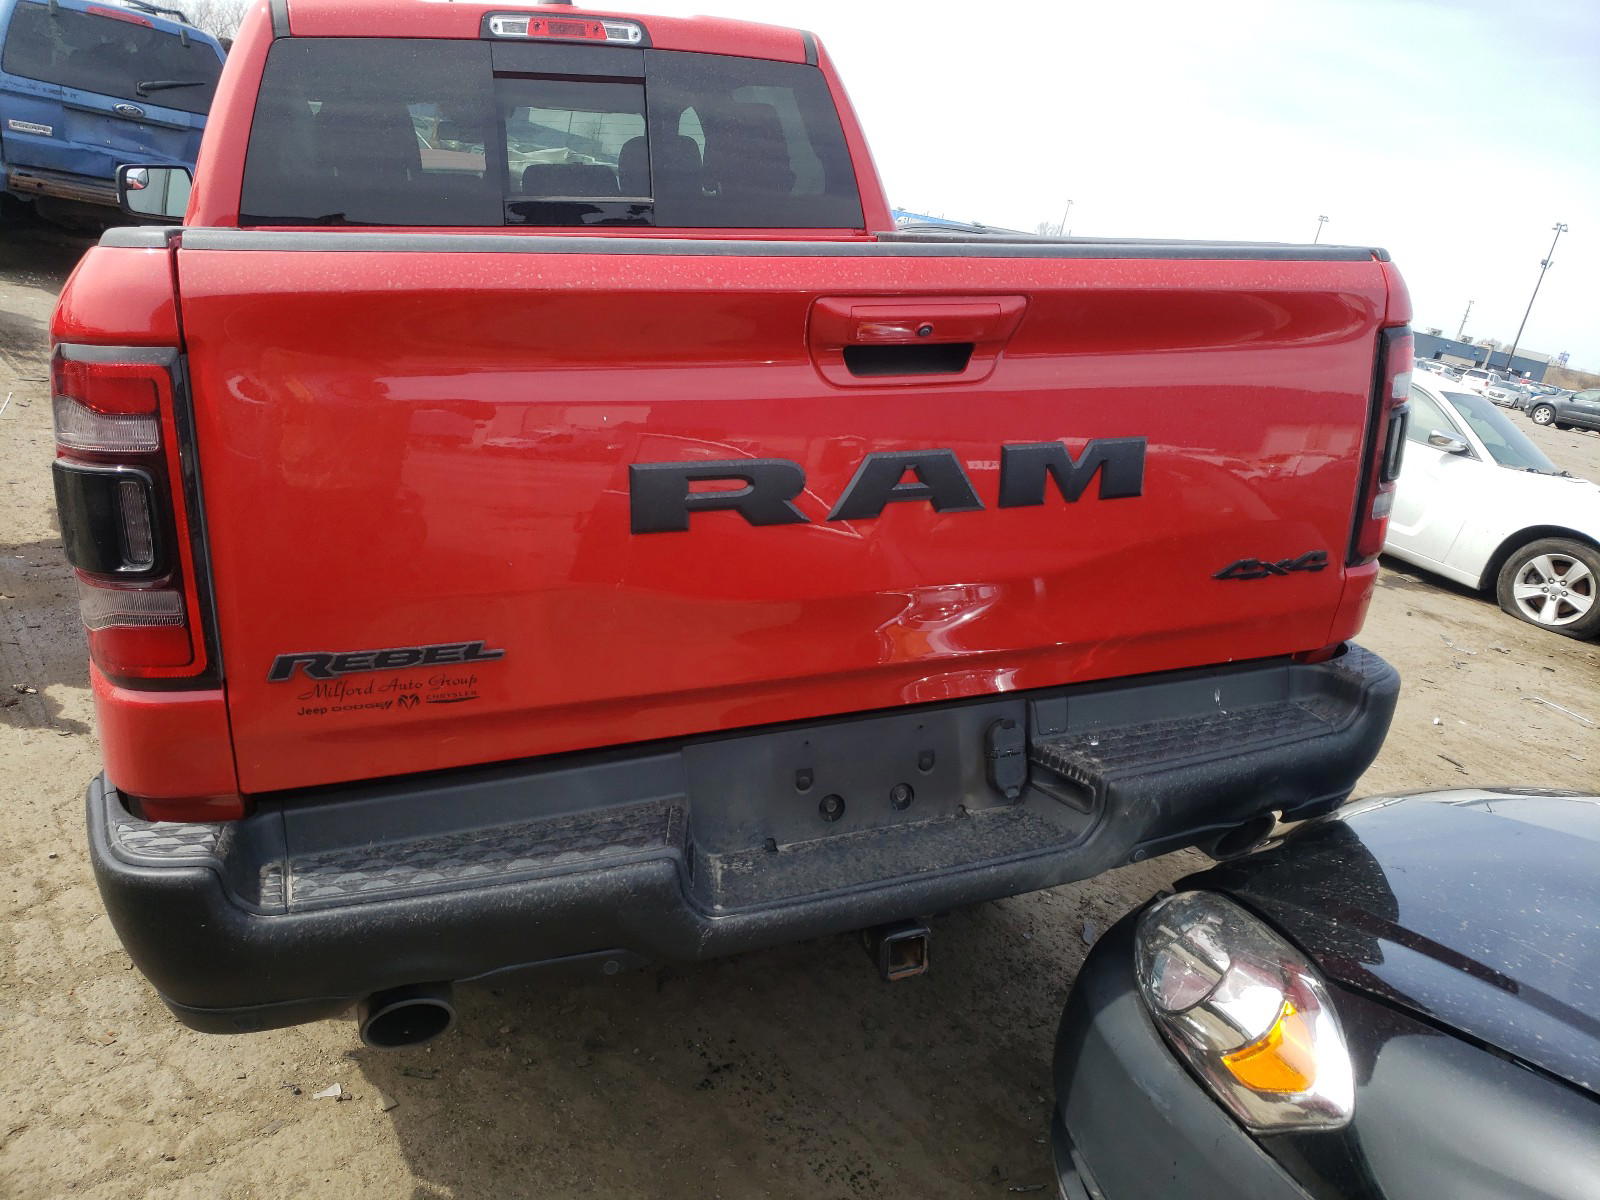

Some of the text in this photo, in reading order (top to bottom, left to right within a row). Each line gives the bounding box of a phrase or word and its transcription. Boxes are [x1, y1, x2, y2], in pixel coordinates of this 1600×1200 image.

[628, 436, 1148, 534] RAM
[267, 640, 505, 683] REBEL
[297, 674, 478, 702] Milford Auto Group
[297, 706, 328, 716] Jeep
